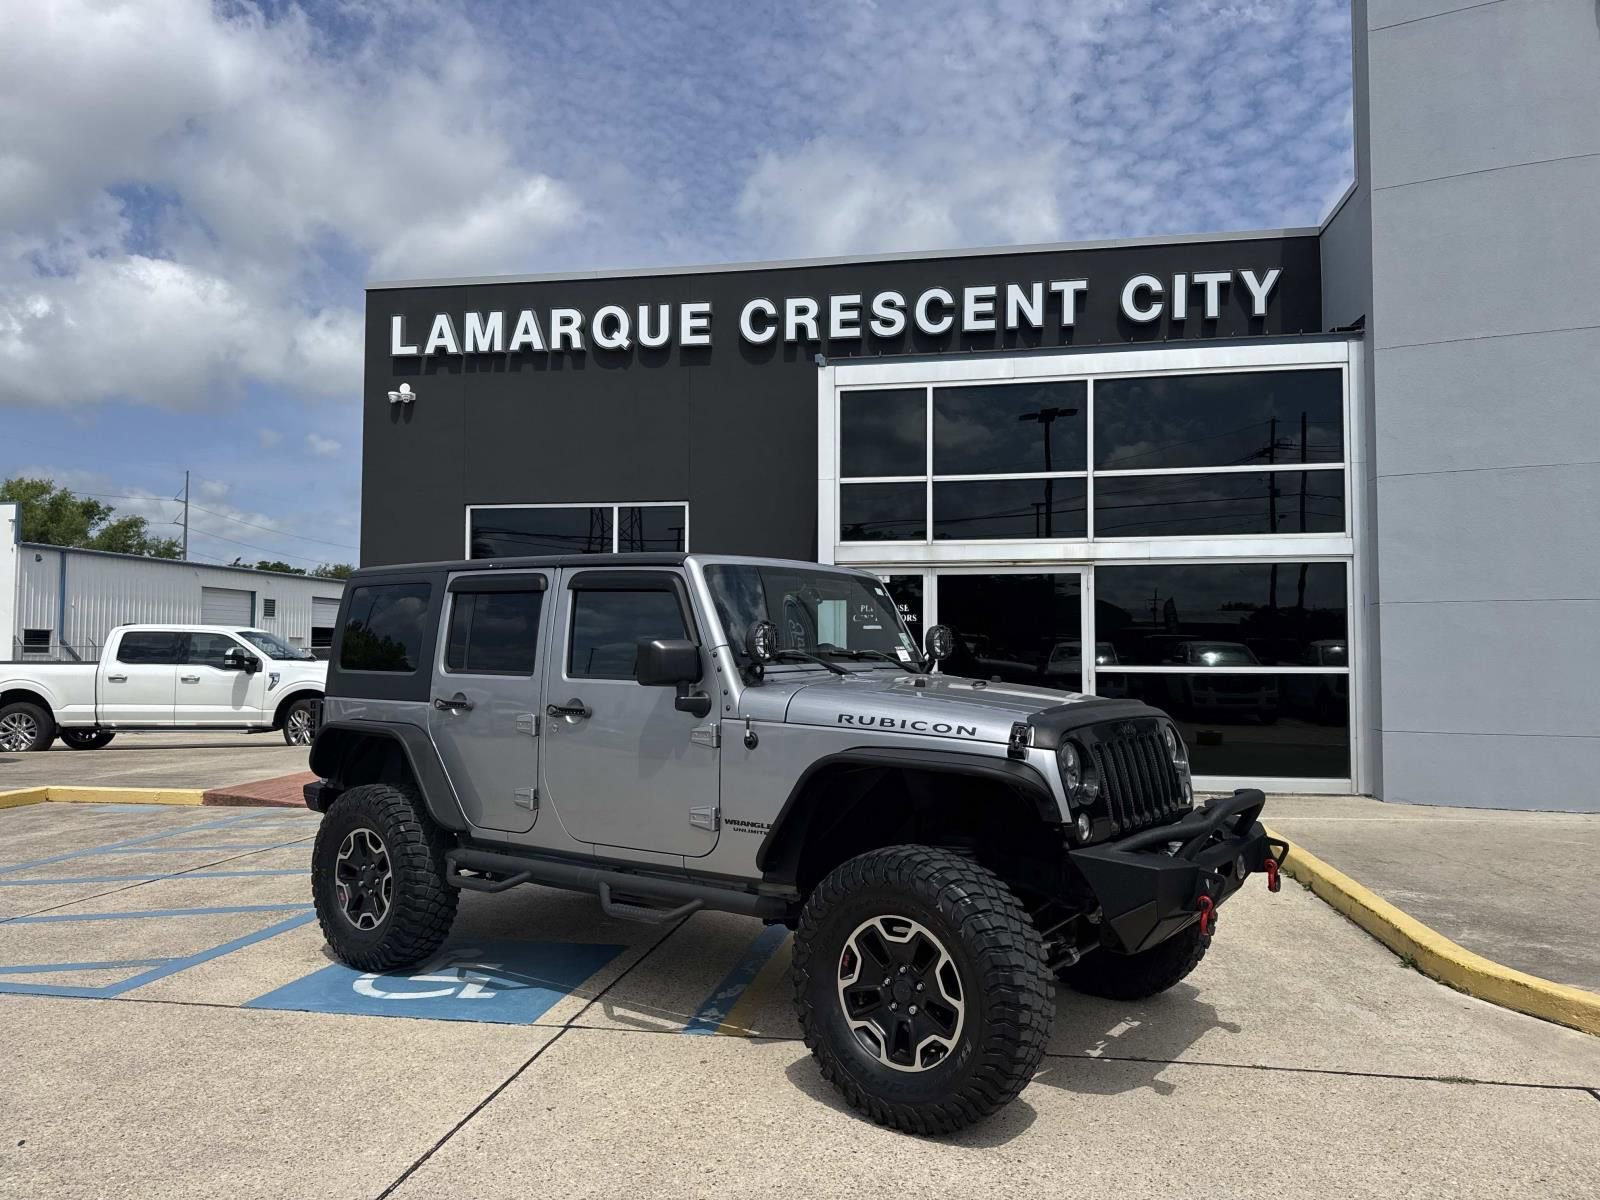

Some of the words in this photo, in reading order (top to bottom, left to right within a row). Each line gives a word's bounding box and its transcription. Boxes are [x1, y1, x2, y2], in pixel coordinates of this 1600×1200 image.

[390, 302, 712, 356] LAMARQUE
[739, 279, 1087, 345] CRESCENT
[1121, 268, 1283, 323] CITY
[837, 714, 977, 736] RUBICON
[724, 818, 773, 829] WRANGLE
[733, 827, 768, 835] UNLIMIT
